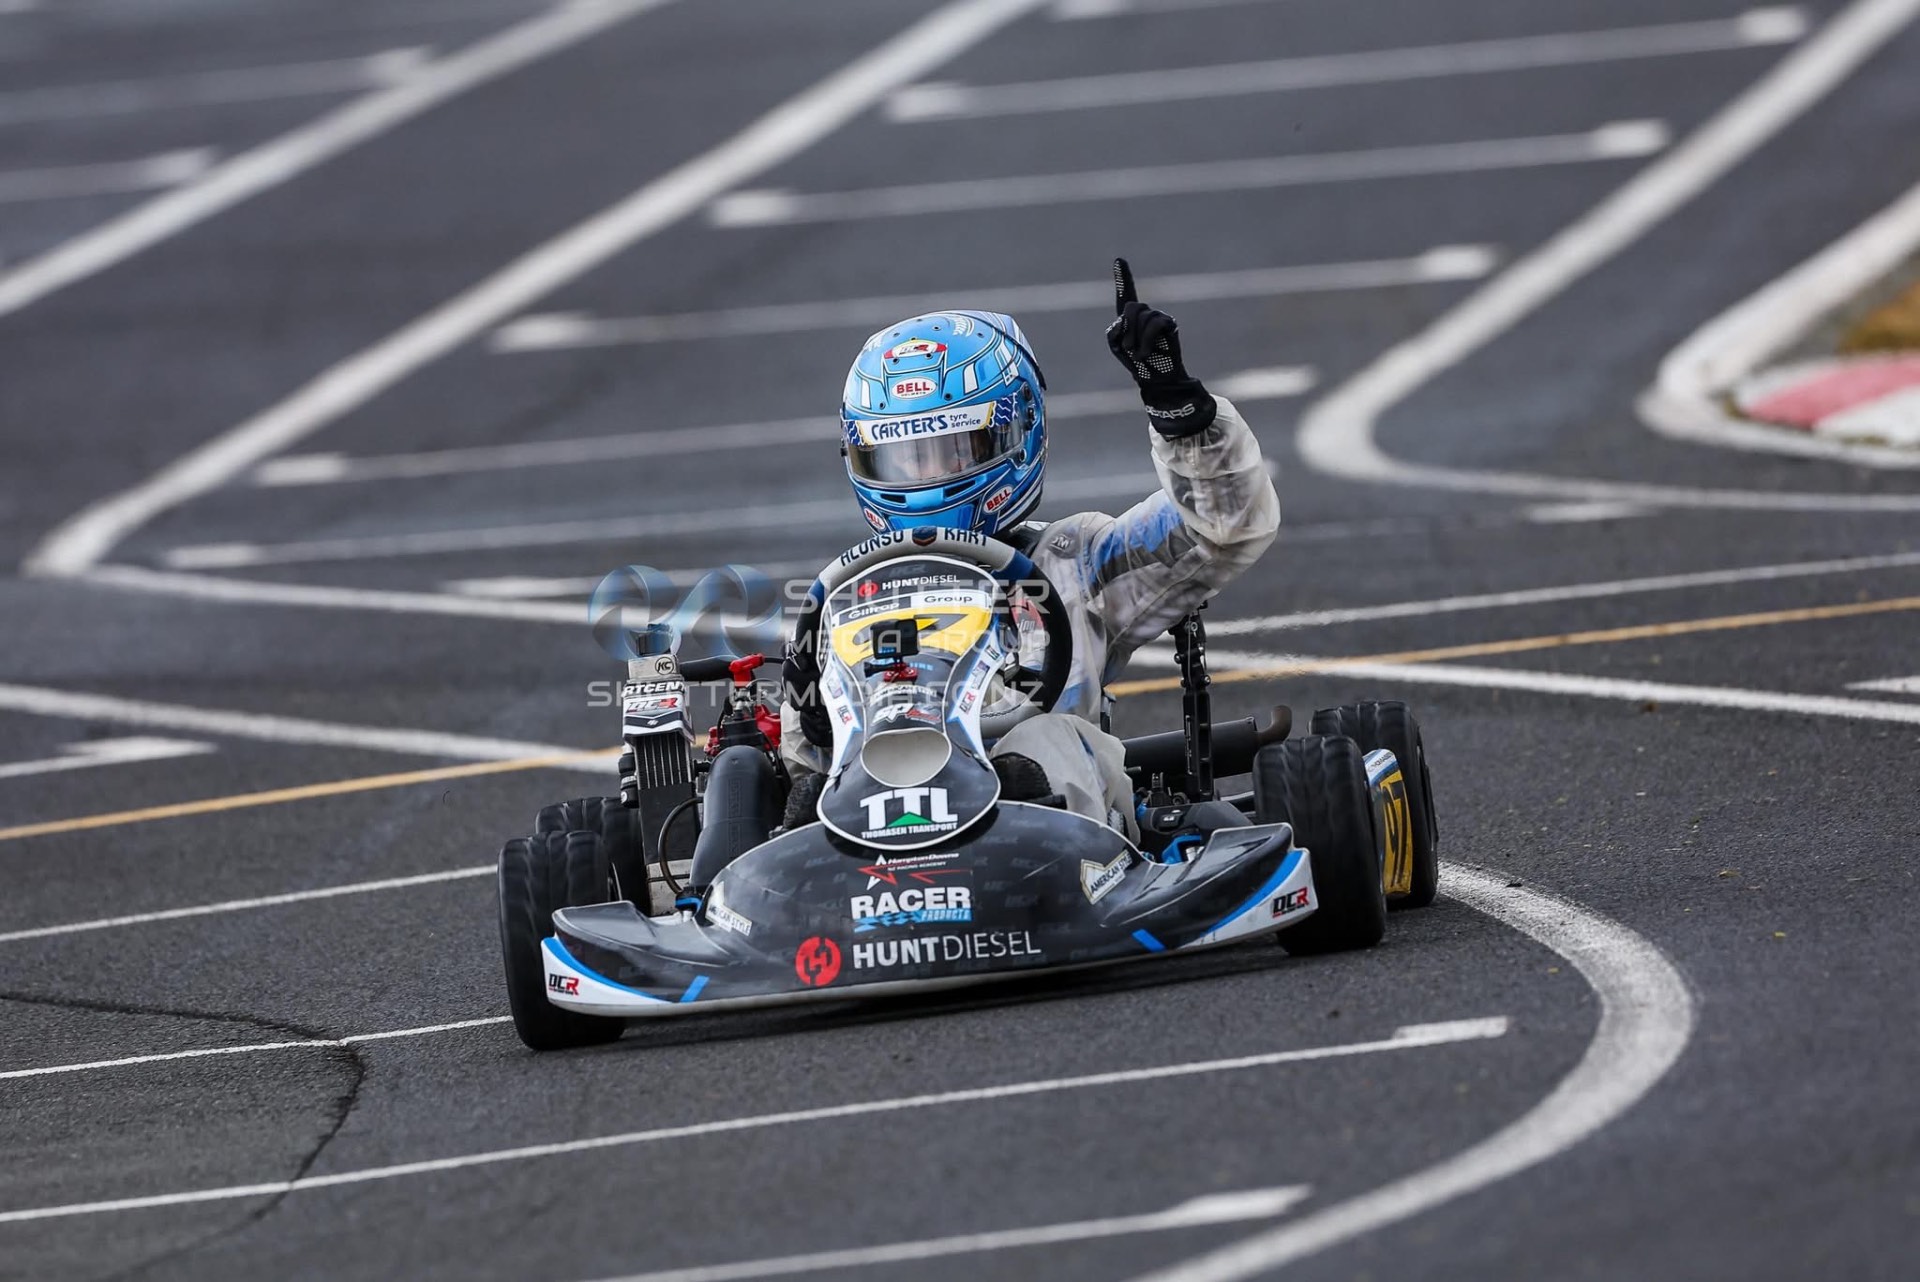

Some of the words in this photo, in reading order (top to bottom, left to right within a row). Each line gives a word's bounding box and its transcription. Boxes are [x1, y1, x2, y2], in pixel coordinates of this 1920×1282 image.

[897, 382, 931, 394] BELL
[871, 415, 948, 441] CARTER'S
[950, 413, 968, 422] tyre
[951, 418, 981, 429] service
[985, 488, 1011, 513] BELL
[866, 509, 885, 528] BELL
[848, 603, 899, 619] Giltrap
[924, 595, 973, 604] Group
[860, 787, 958, 831] TTL
[861, 826, 908, 840] THOMASEN
[908, 822, 958, 834] TRANSPORT
[851, 886, 972, 920] RACER
